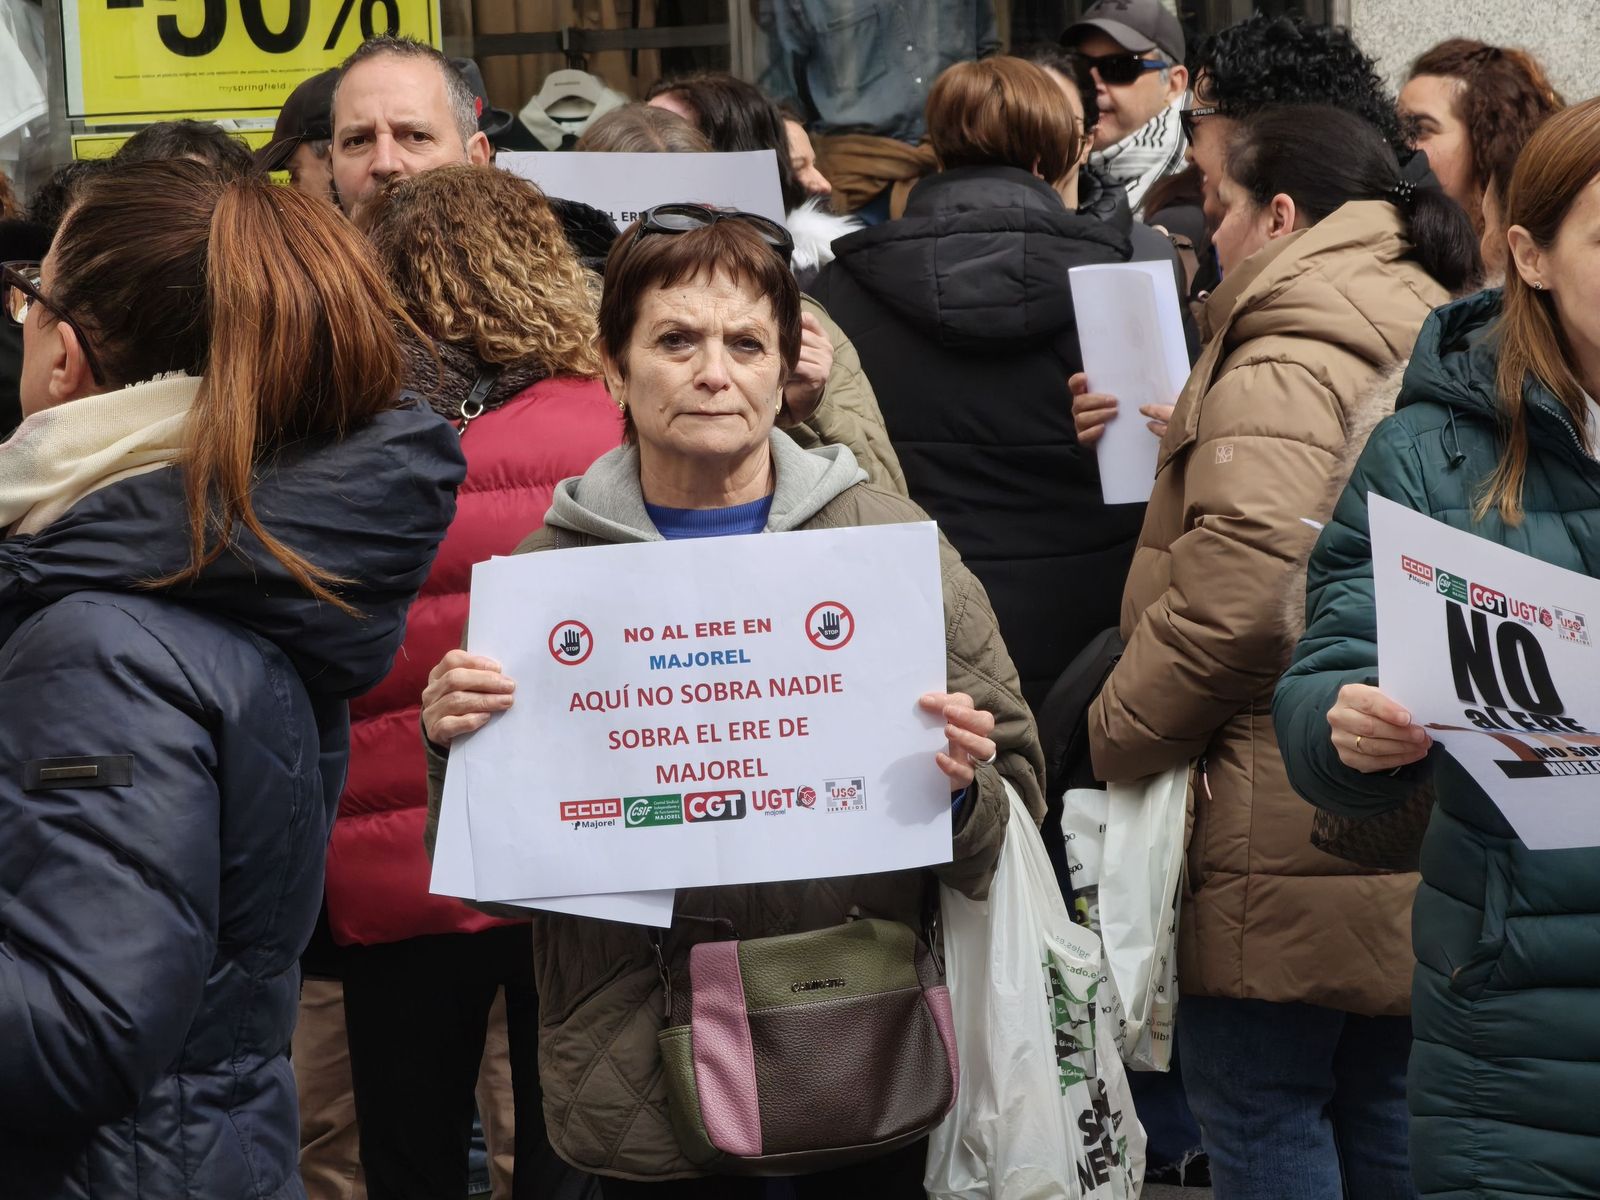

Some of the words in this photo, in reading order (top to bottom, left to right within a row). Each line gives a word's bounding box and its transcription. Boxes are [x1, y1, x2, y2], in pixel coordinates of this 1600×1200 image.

[1472, 588, 1505, 614] CGT
[1509, 598, 1538, 623] UGT
[623, 626, 655, 643] NO
[661, 624, 689, 641] AL
[695, 620, 737, 638] ERE
[743, 618, 772, 634] EN
[649, 648, 752, 671] MAJOREL
[1445, 600, 1564, 715] NO
[569, 683, 630, 713] AQUÍ
[637, 686, 673, 708] NO
[680, 679, 763, 705] SOBRA
[768, 673, 844, 698] NADIE
[608, 725, 690, 750] SOBRA
[696, 723, 722, 744] EL
[728, 719, 771, 741] ERE
[778, 716, 809, 738] DE
[656, 757, 768, 785] MAJOREL
[751, 788, 795, 811] UGT
[831, 786, 857, 798] USO
[564, 802, 618, 817] CCOO
[688, 793, 742, 819] CGT
[581, 819, 616, 829] Majorel
